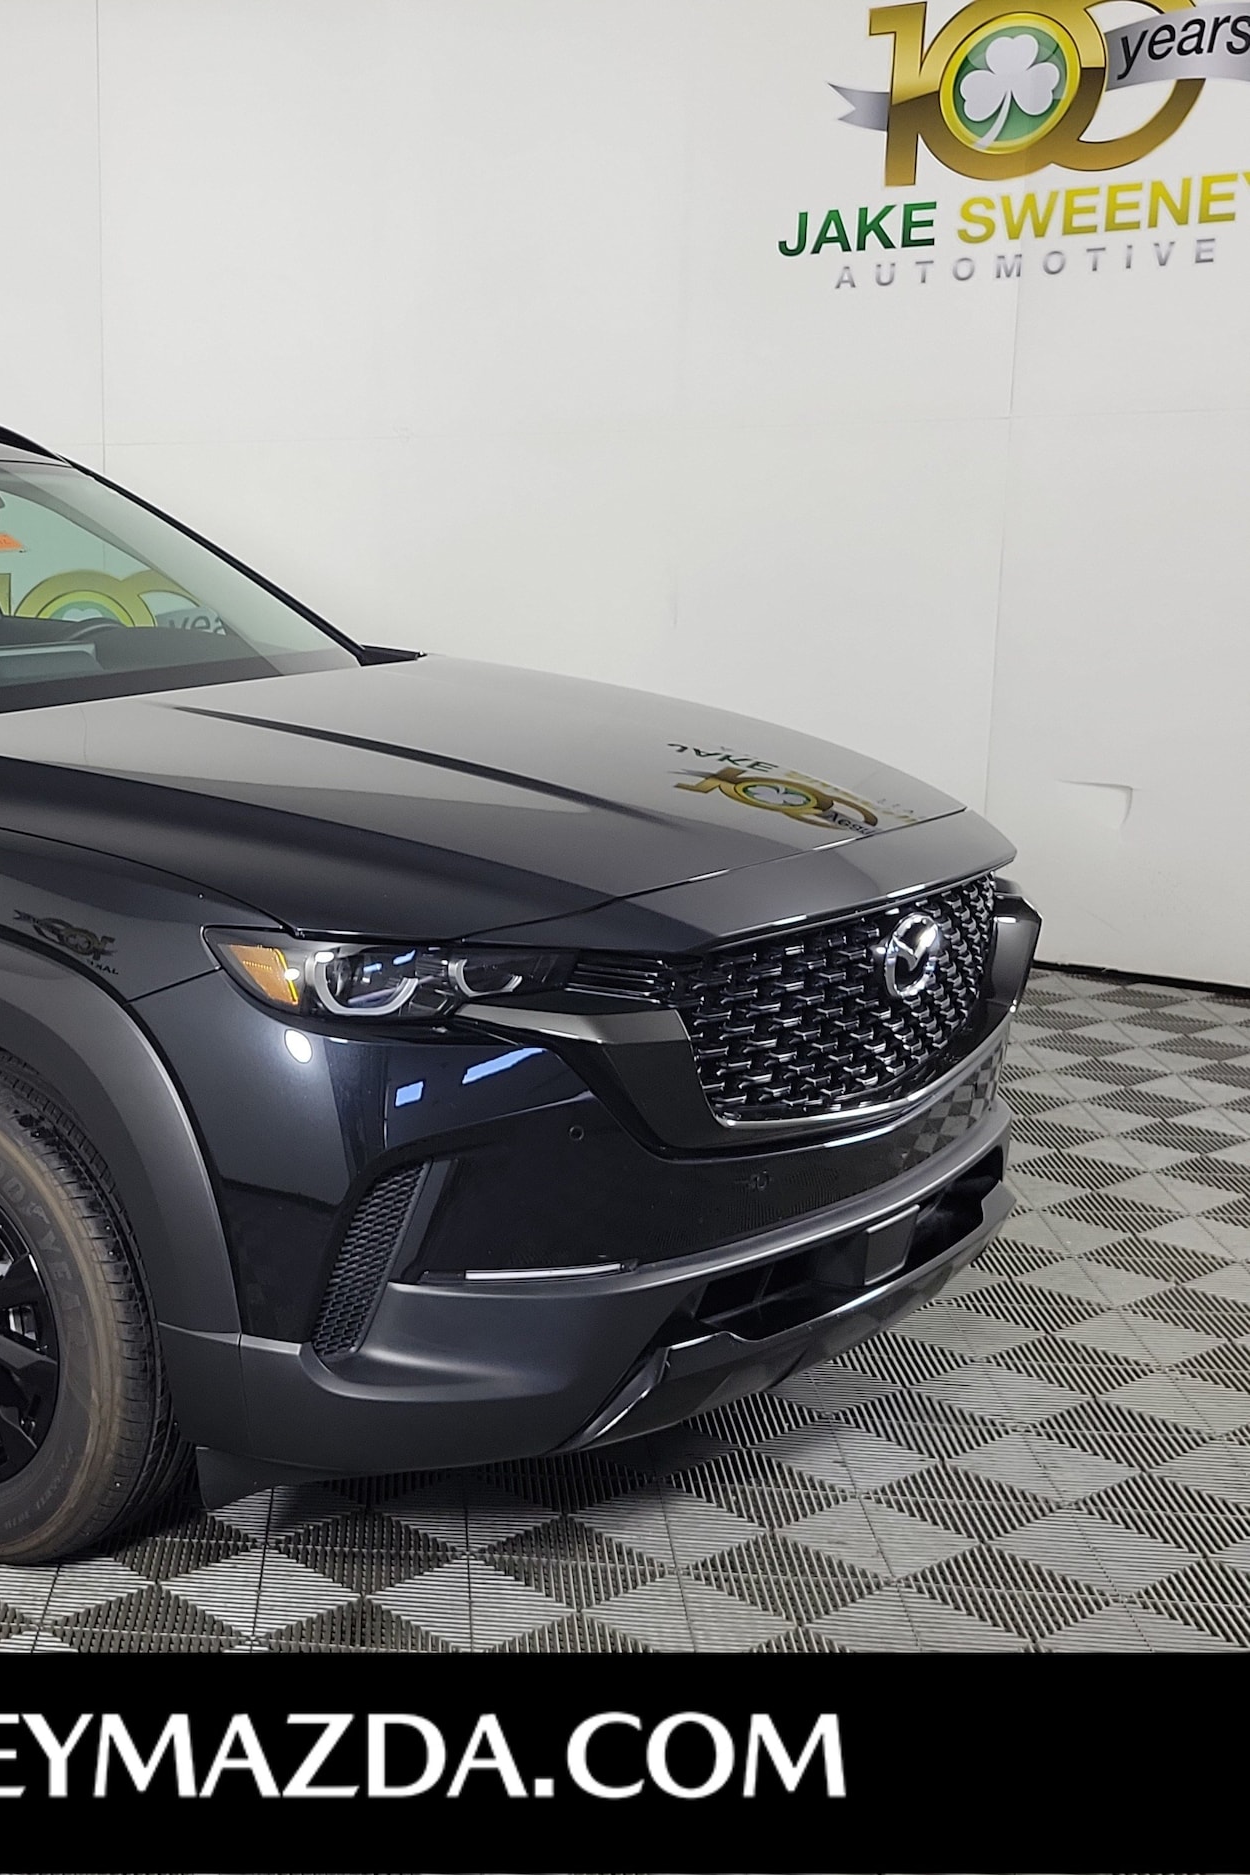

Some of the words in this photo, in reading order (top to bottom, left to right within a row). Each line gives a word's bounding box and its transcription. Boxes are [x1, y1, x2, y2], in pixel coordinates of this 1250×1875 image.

[1117, 15, 1250, 80] years
[778, 201, 937, 257] JAKE
[957, 171, 1250, 244] SWEENE
[835, 238, 1215, 289] AUTOMOTIVE
